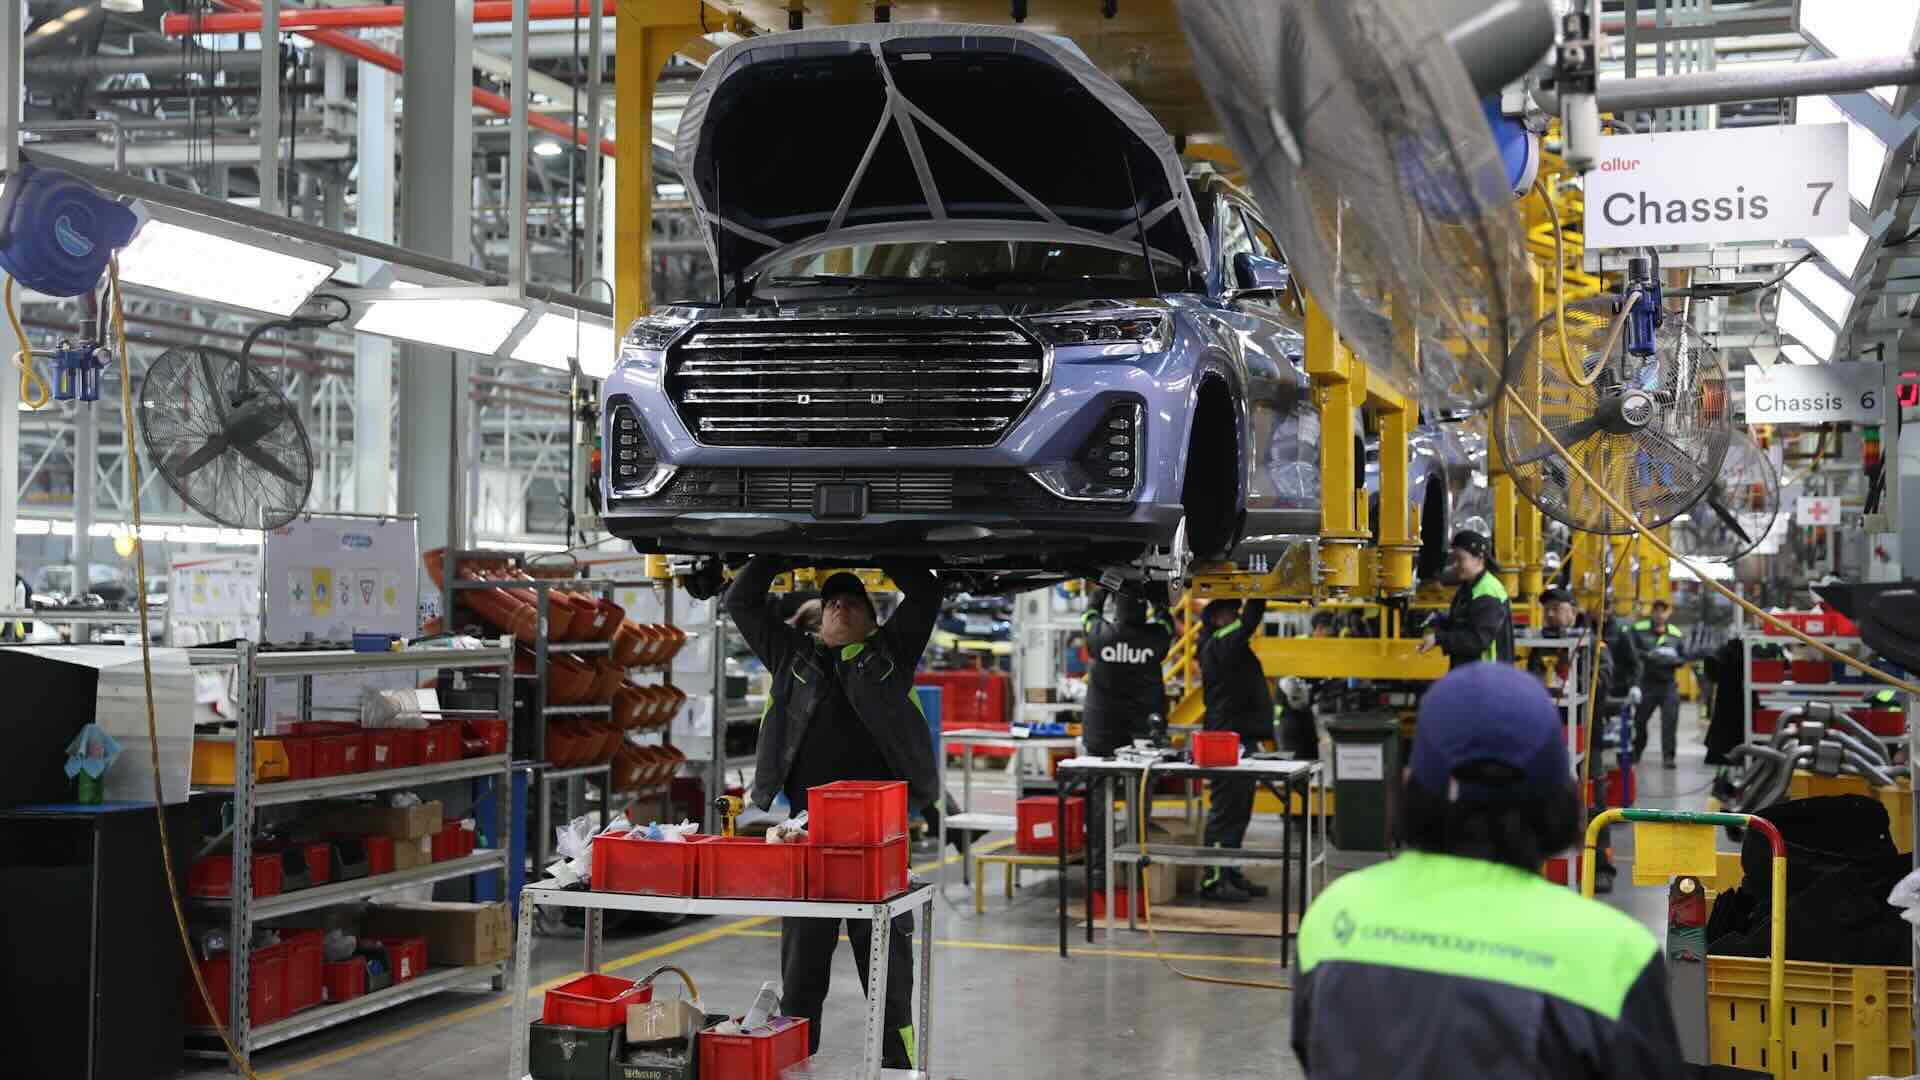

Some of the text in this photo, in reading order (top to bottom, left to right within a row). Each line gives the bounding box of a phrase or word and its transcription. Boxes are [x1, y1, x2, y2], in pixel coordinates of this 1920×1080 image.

[1601, 158, 1641, 173] allur
[1602, 181, 1834, 227] Chassis 7
[1755, 391, 1875, 412] Chassis 6
[1101, 642, 1154, 664] allur
